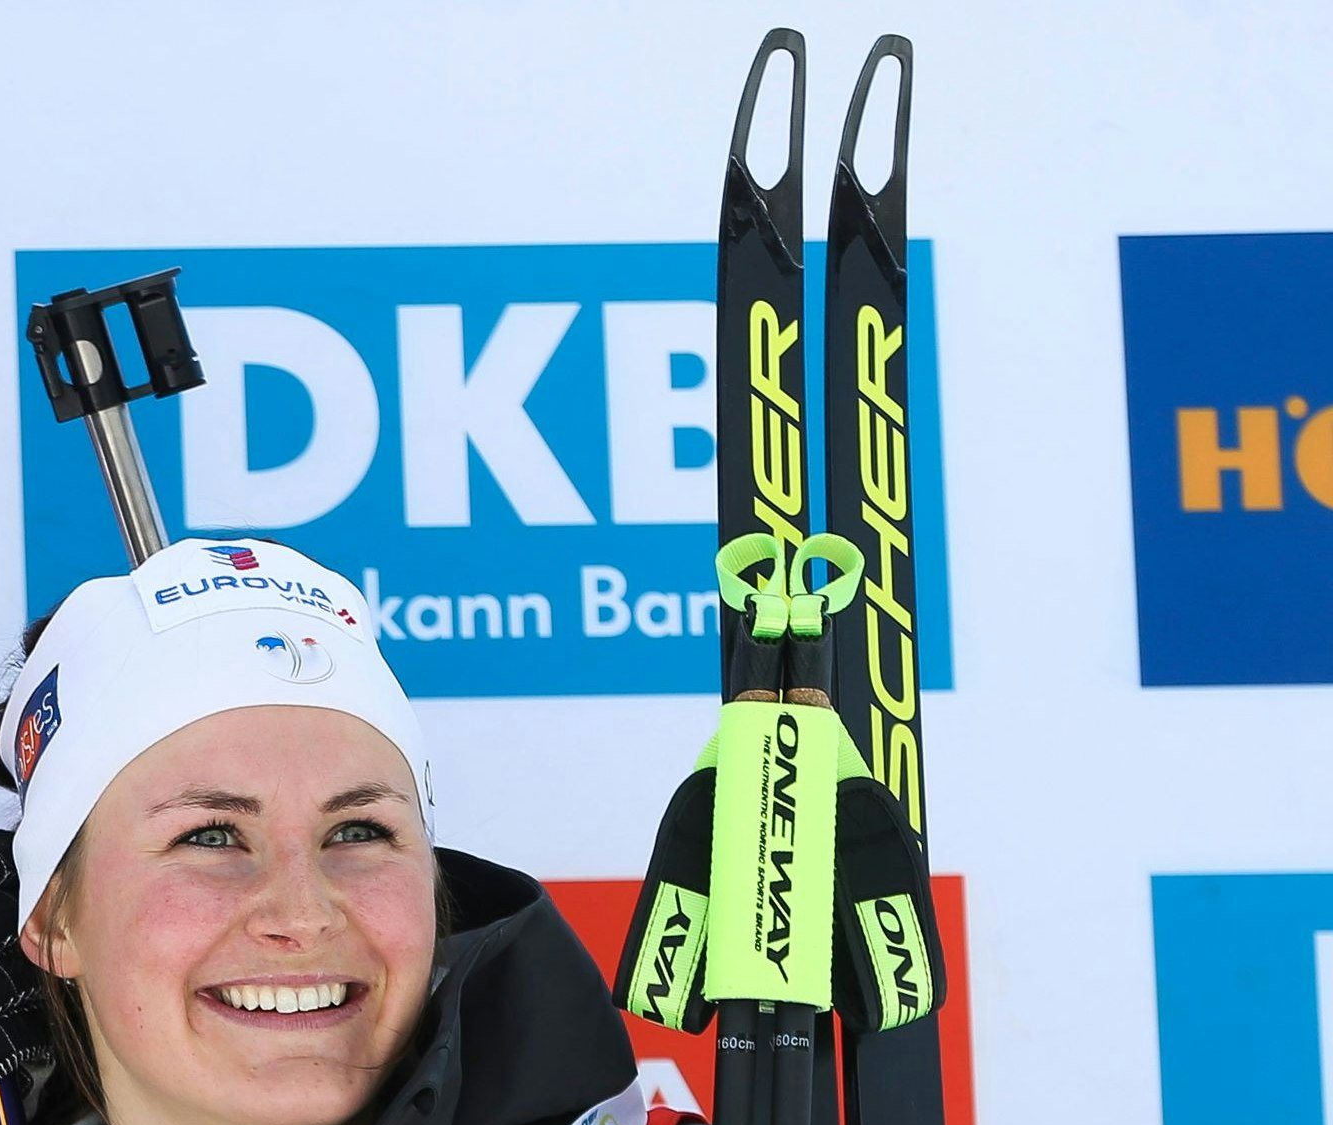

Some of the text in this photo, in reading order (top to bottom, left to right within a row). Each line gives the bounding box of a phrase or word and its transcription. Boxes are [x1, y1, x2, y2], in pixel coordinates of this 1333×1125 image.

[181, 300, 718, 530] DKB
[155, 576, 332, 605] EUROVIA
[582, 566, 724, 640] Ban
[759, 757, 770, 820] AUTHENTIC
[758, 821, 767, 865] NORDIC
[766, 712, 800, 984] ONE WAY
[756, 867, 765, 906] SPORTS
[754, 908, 763, 953] BRAND
[775, 1033, 810, 1048] 60cm
